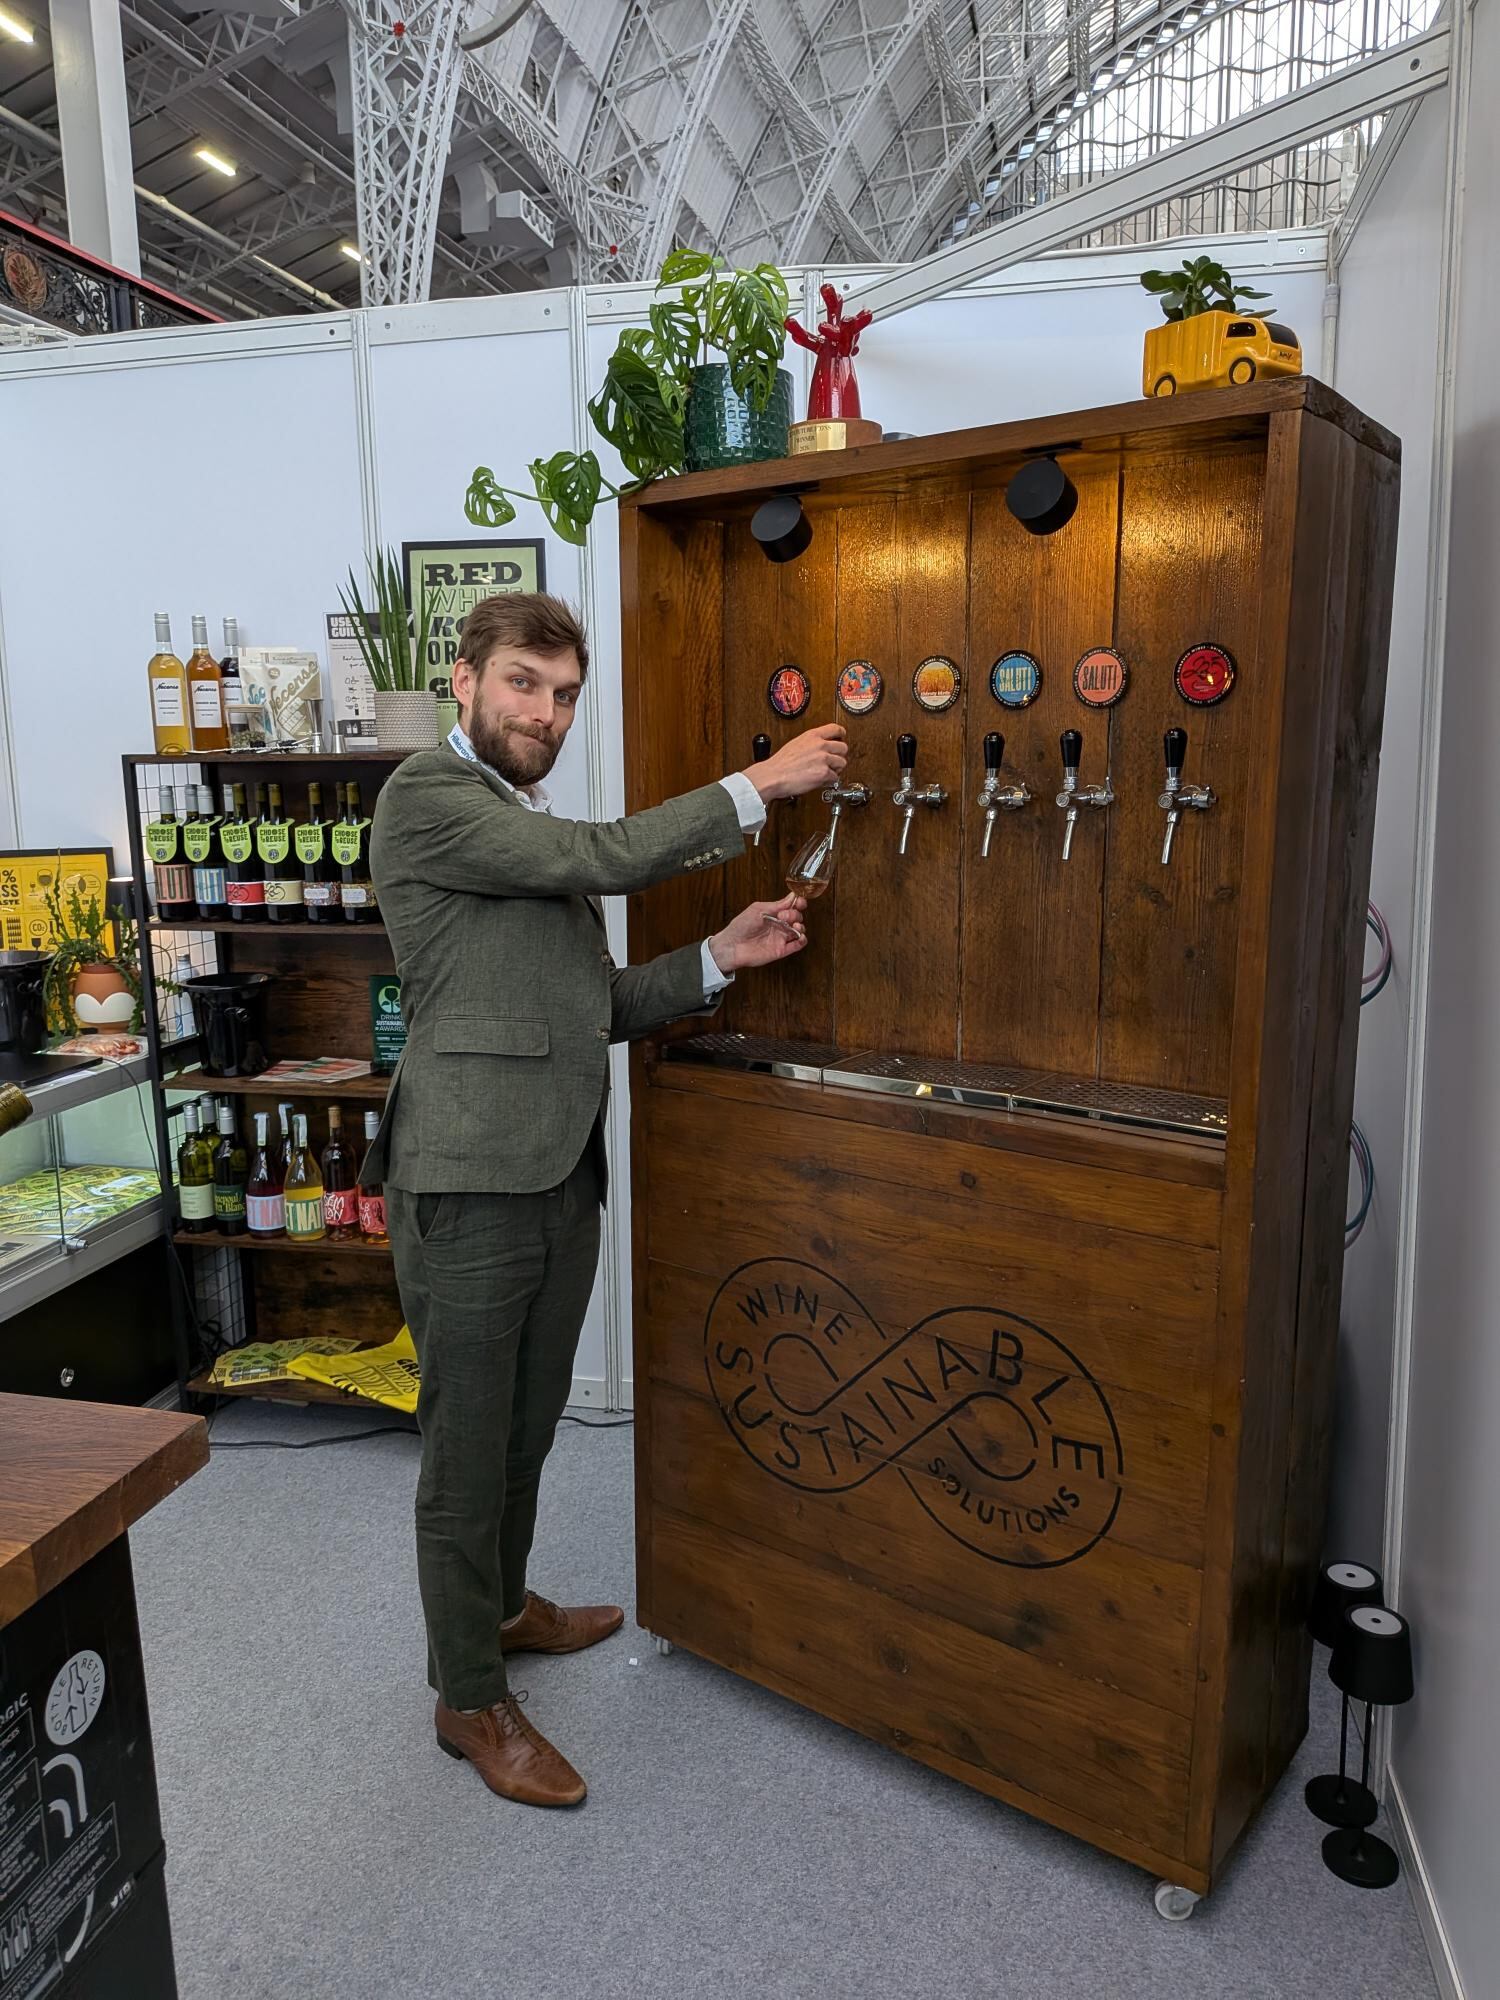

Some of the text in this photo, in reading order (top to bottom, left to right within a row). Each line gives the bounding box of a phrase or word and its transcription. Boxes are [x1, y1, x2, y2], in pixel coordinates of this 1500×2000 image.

[424, 561, 522, 586] RED
[425, 587, 522, 613] WHI
[330, 616, 361, 627] USER
[999, 666, 1031, 692] SALUTI
[1082, 665, 1117, 691] SALUTI
[737, 1284, 853, 1345] WINE
[716, 1329, 1105, 1480] SUSTAINABLE
[927, 1456, 1082, 1535] SOLUTIONS
[81, 1657, 101, 1706] RETURN
